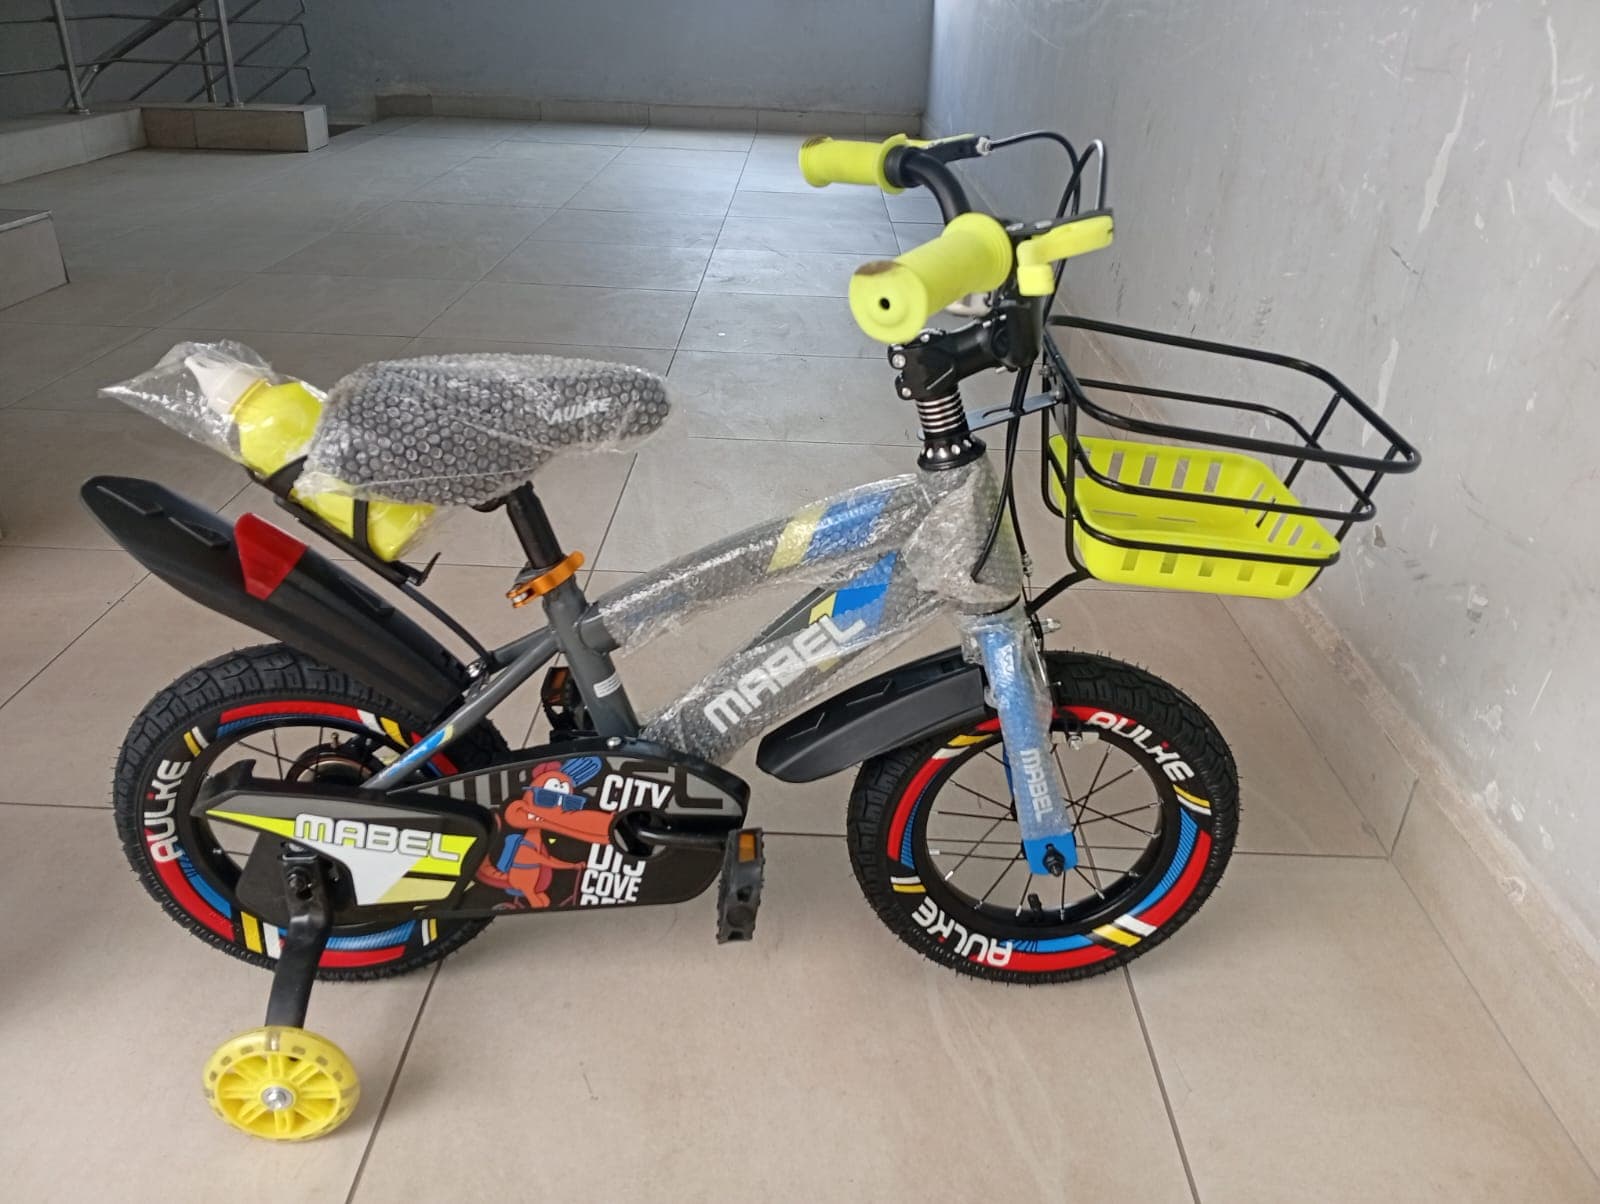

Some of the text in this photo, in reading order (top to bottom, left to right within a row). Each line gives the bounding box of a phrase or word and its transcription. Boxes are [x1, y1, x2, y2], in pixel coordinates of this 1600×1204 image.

[703, 615, 866, 734] MABEL
[1085, 711, 1195, 782] AULKE
[143, 760, 191, 864] AULKE
[599, 774, 671, 812] CITY
[1020, 748, 1054, 822] MABEL
[293, 813, 462, 862] MABEL
[580, 869, 642, 902] COVE
[911, 895, 1013, 967] AULKE
